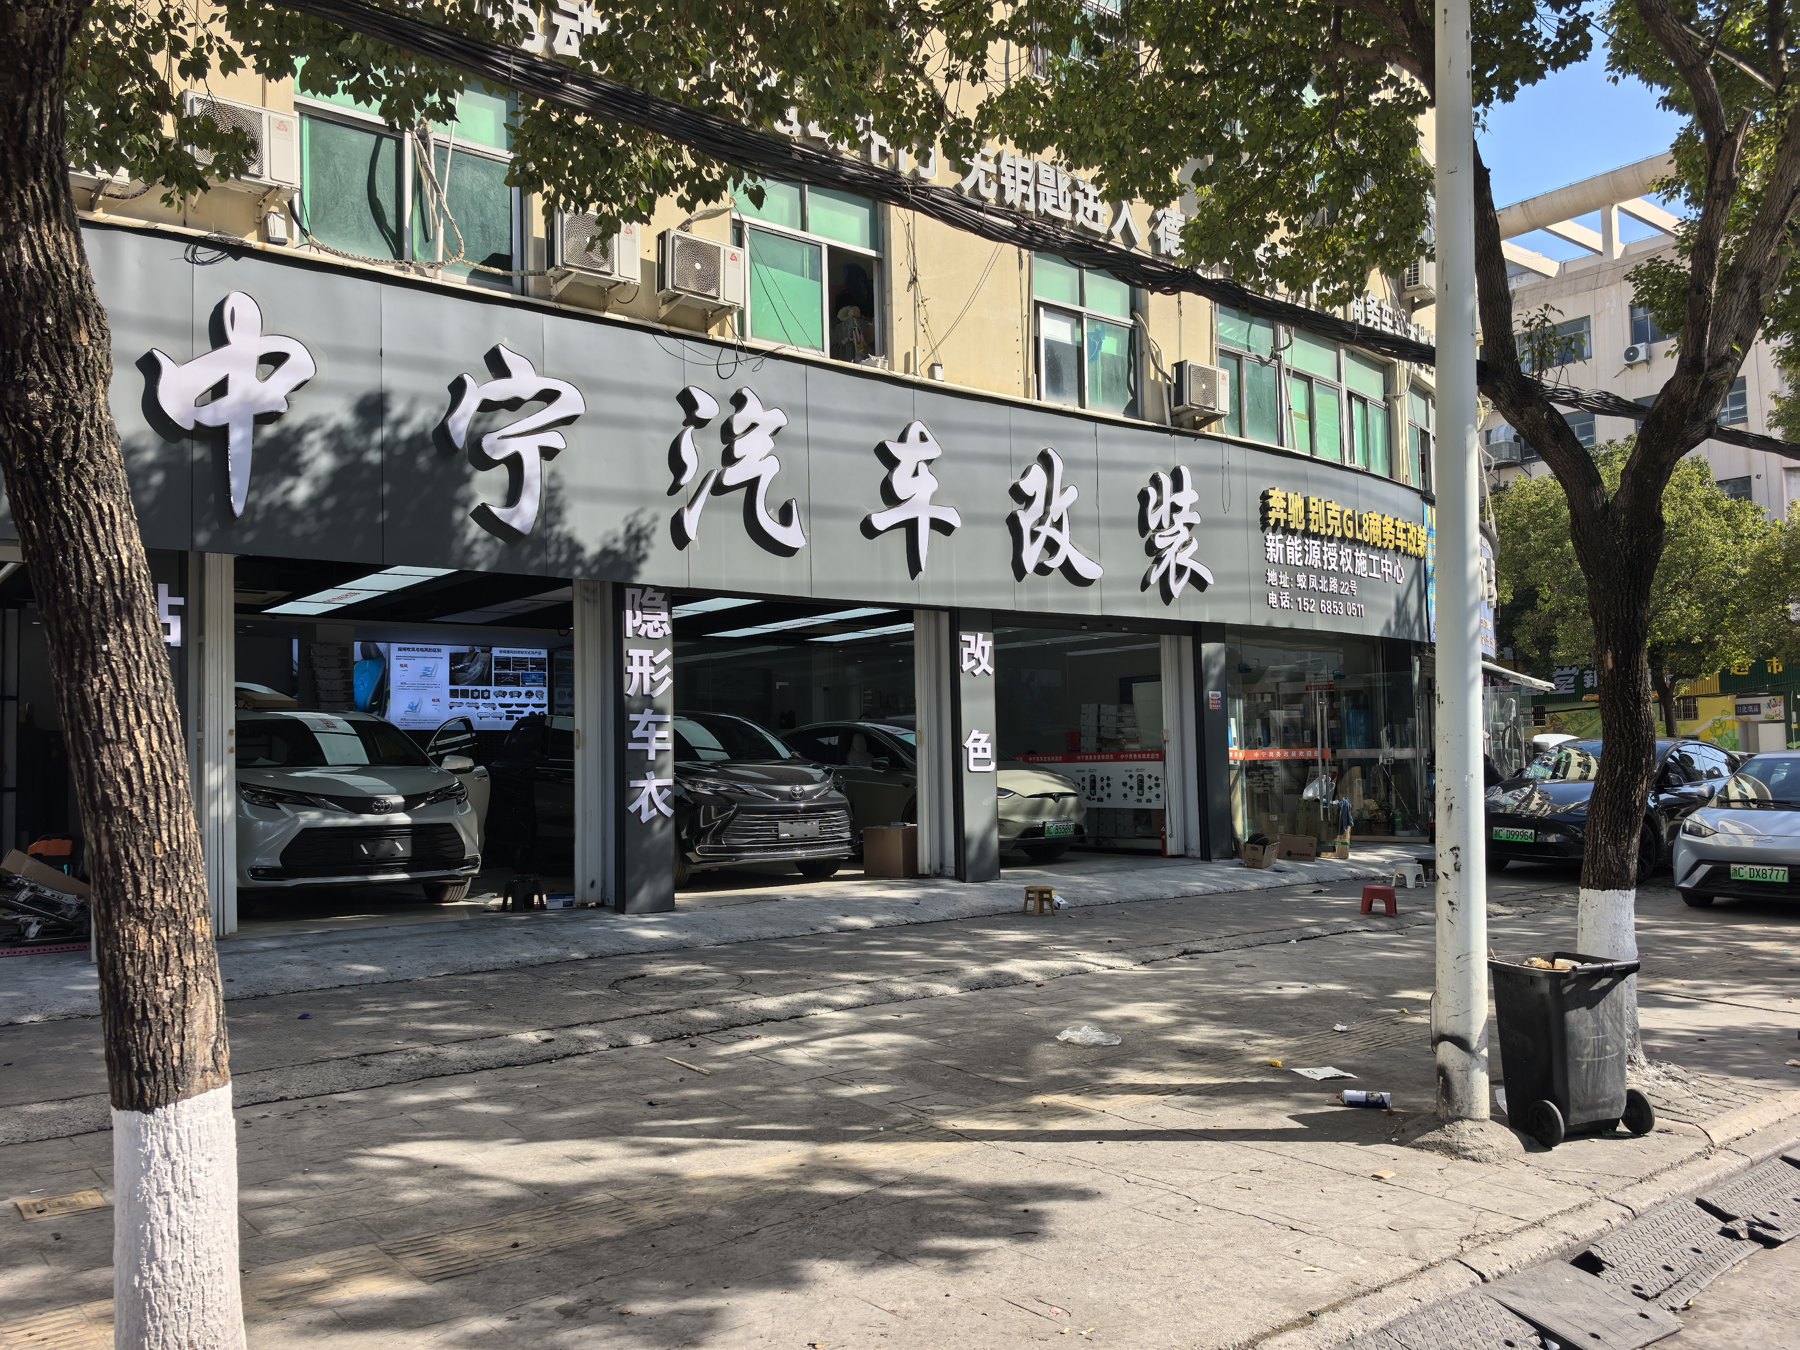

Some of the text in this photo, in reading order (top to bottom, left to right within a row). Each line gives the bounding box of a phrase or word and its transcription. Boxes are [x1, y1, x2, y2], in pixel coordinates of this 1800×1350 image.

[140, 290, 1214, 600] 中宁汽车改装
[1268, 487, 1305, 530] 奔驰
[1265, 532, 1405, 584] 新能源授权施工中心
[623, 587, 676, 824] 隐形车衣
